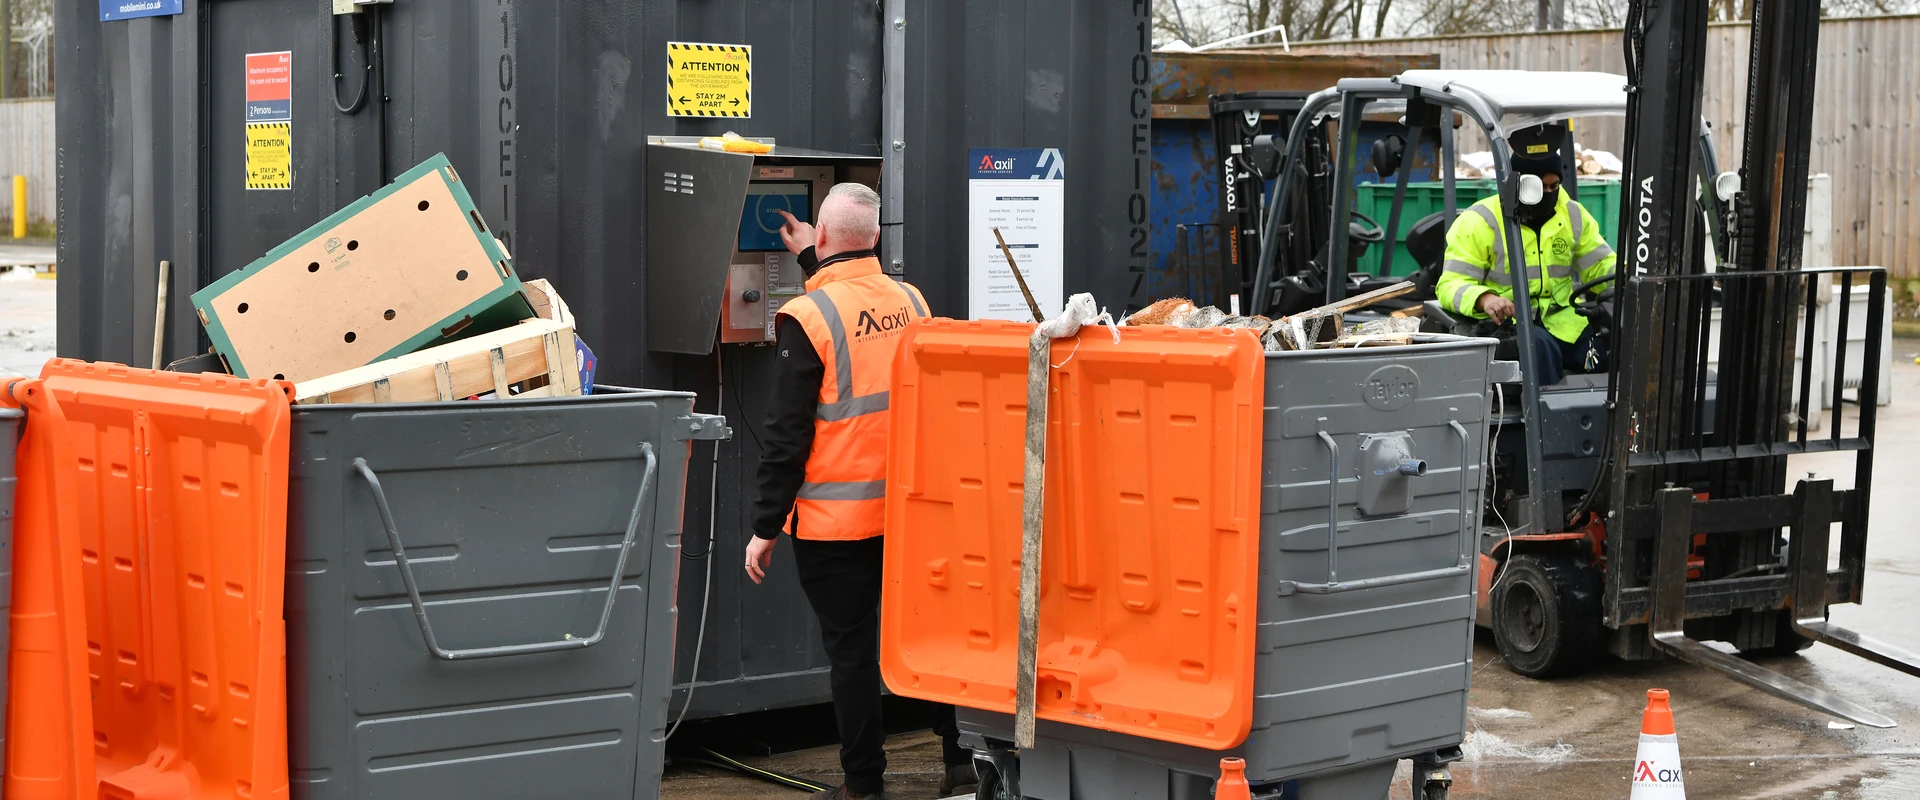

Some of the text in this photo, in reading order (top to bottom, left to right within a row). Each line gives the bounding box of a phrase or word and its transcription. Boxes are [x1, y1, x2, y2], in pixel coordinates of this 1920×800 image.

[120, 1, 161, 13] mobilemini.co.uk
[681, 61, 740, 72] ATTENTION
[254, 106, 272, 114] Persons
[253, 139, 284, 147] ATTENTION
[994, 158, 1013, 170] axil
[1225, 156, 1236, 212] TOYOTA
[1635, 176, 1654, 277] TOYOTA
[1230, 225, 1238, 264] RENTAL
[881, 307, 910, 331] axil
[855, 332, 888, 344] INTEGRATED
[1370, 376, 1414, 404] Taylor
